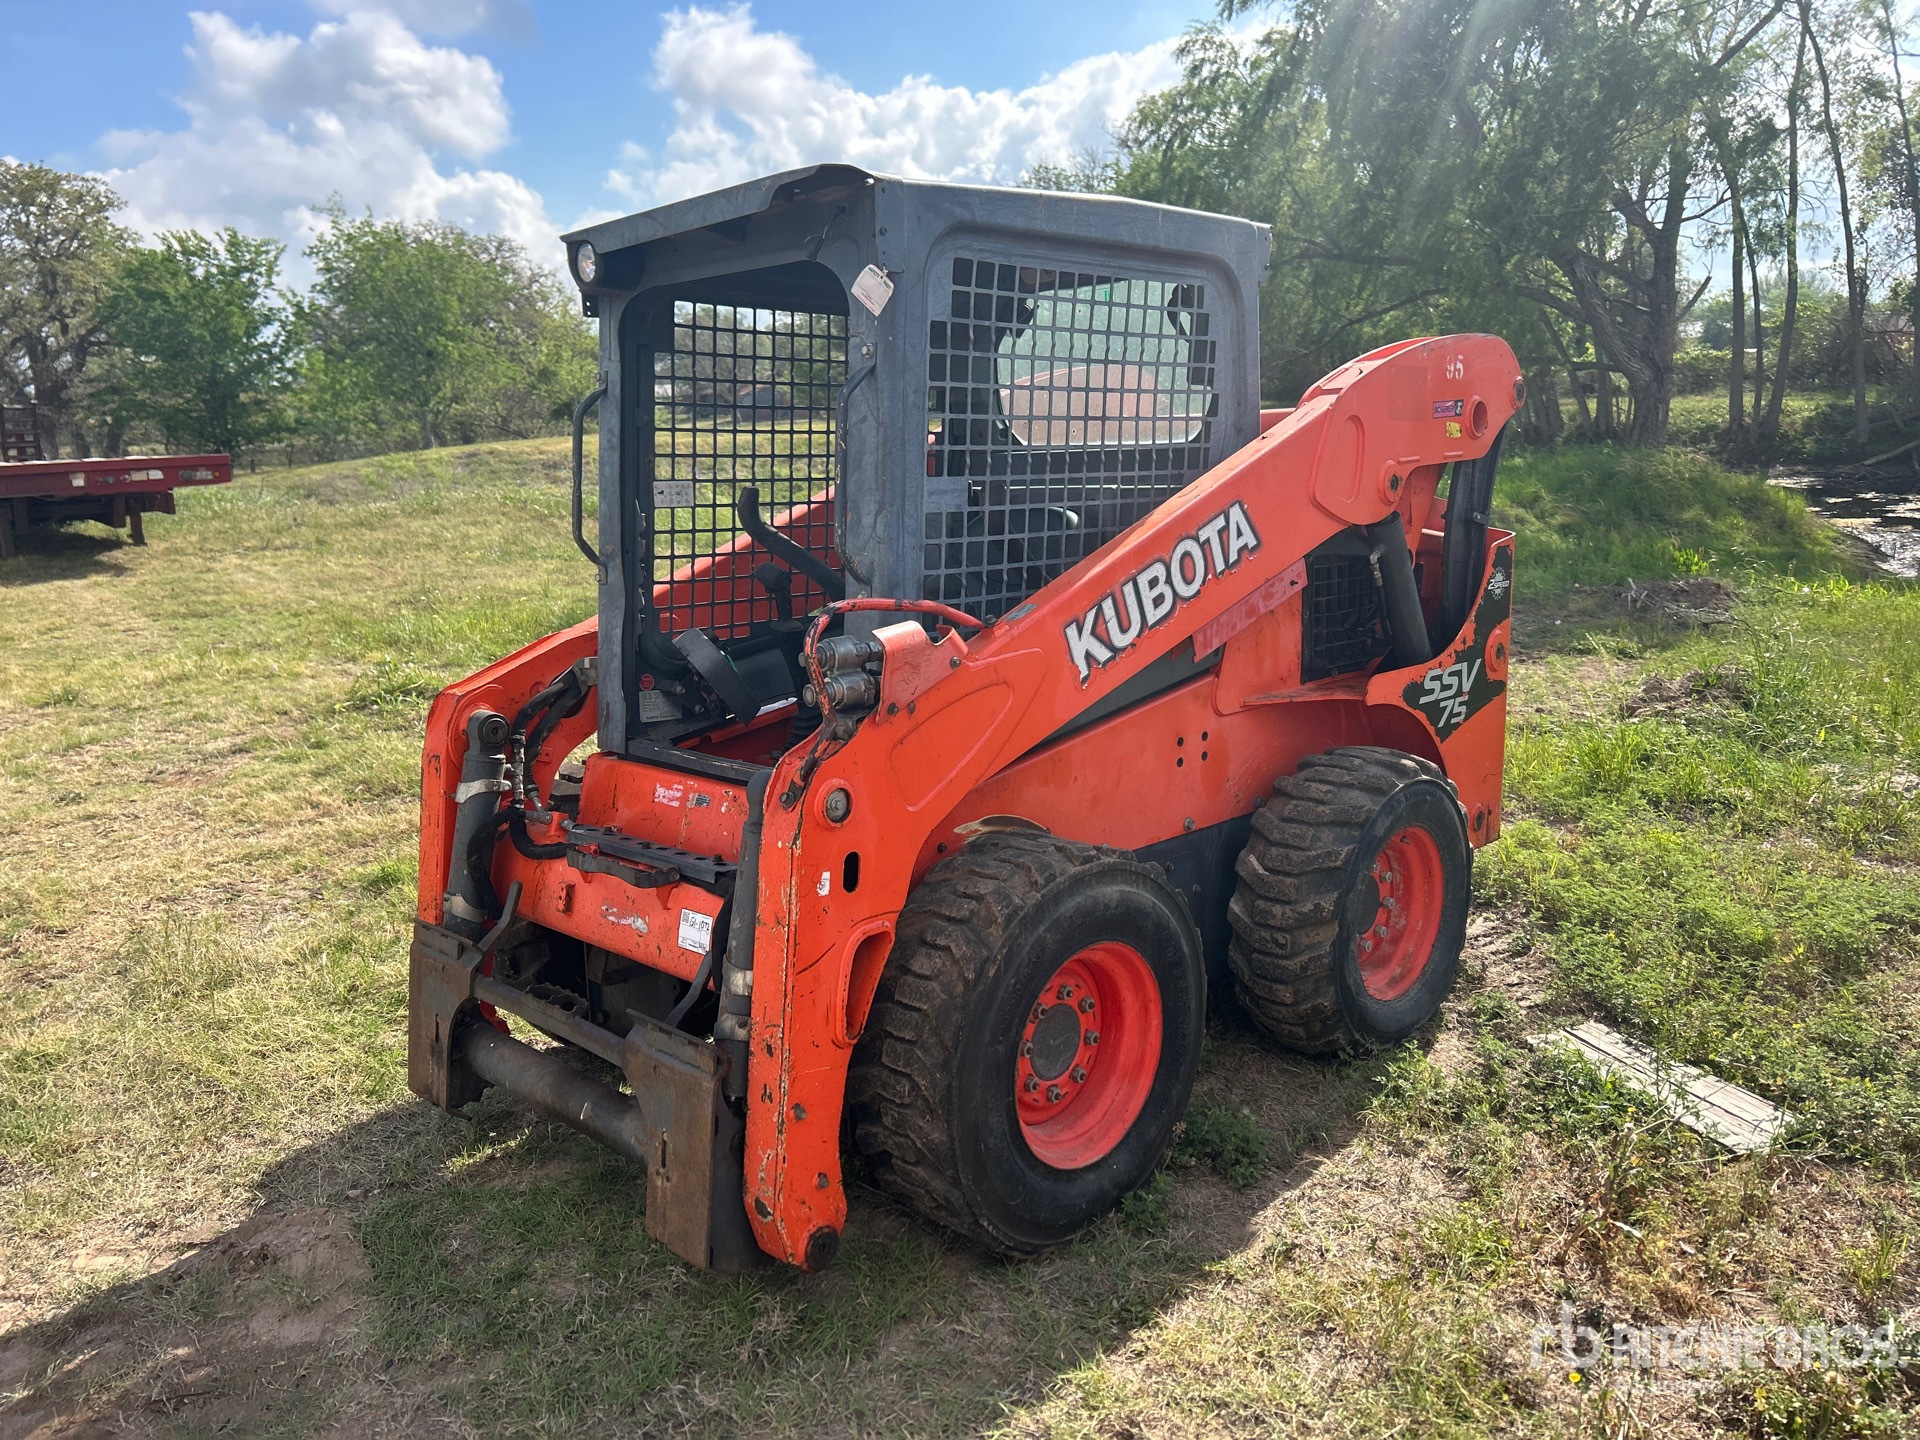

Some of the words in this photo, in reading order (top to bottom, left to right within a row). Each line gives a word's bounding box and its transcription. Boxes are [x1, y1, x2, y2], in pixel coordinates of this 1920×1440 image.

[1064, 502, 1259, 682] KUBOTA
[1419, 658, 1482, 704] SSV
[1437, 695, 1468, 728] 75
